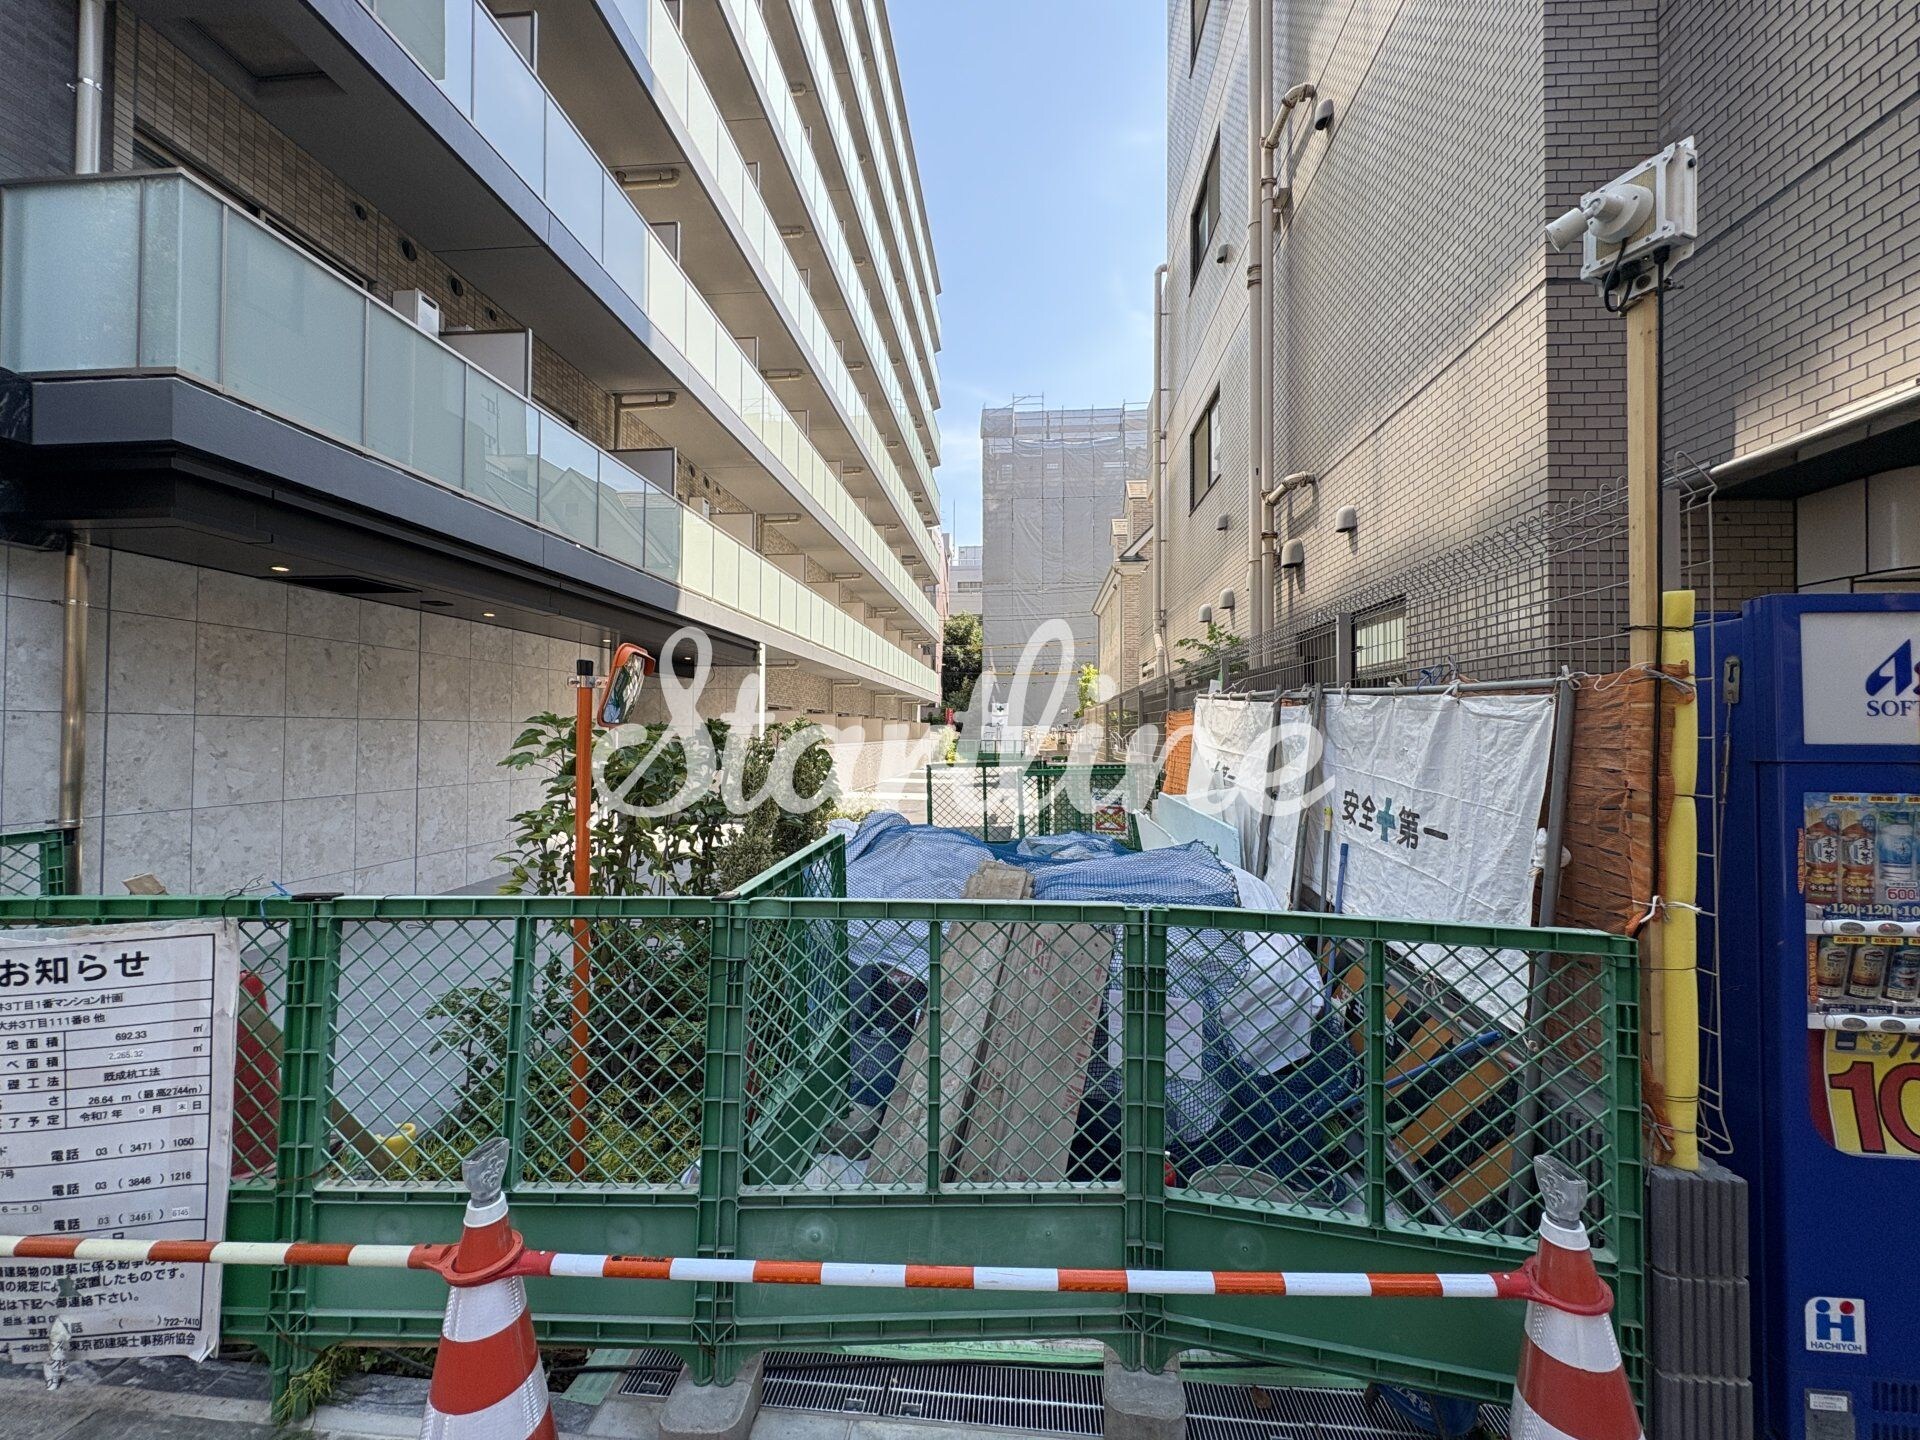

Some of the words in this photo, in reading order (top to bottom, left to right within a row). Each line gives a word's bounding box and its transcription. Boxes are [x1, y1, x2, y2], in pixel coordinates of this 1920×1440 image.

[1822, 838, 1837, 863] 麦茶
[1859, 839, 1873, 864] 麦茶
[0, 951, 150, 987] お知らせ
[115, 1030, 147, 1041] 692.33
[0, 1115, 59, 1129] 了予定
[51, 1148, 79, 1162] 電話
[95, 1147, 108, 1156] 03
[52, 1183, 79, 1197] 電話
[95, 1181, 107, 1190] 03
[54, 1218, 80, 1231] 電話
[69, 1332, 196, 1352] 東京都建築士事務所協会
